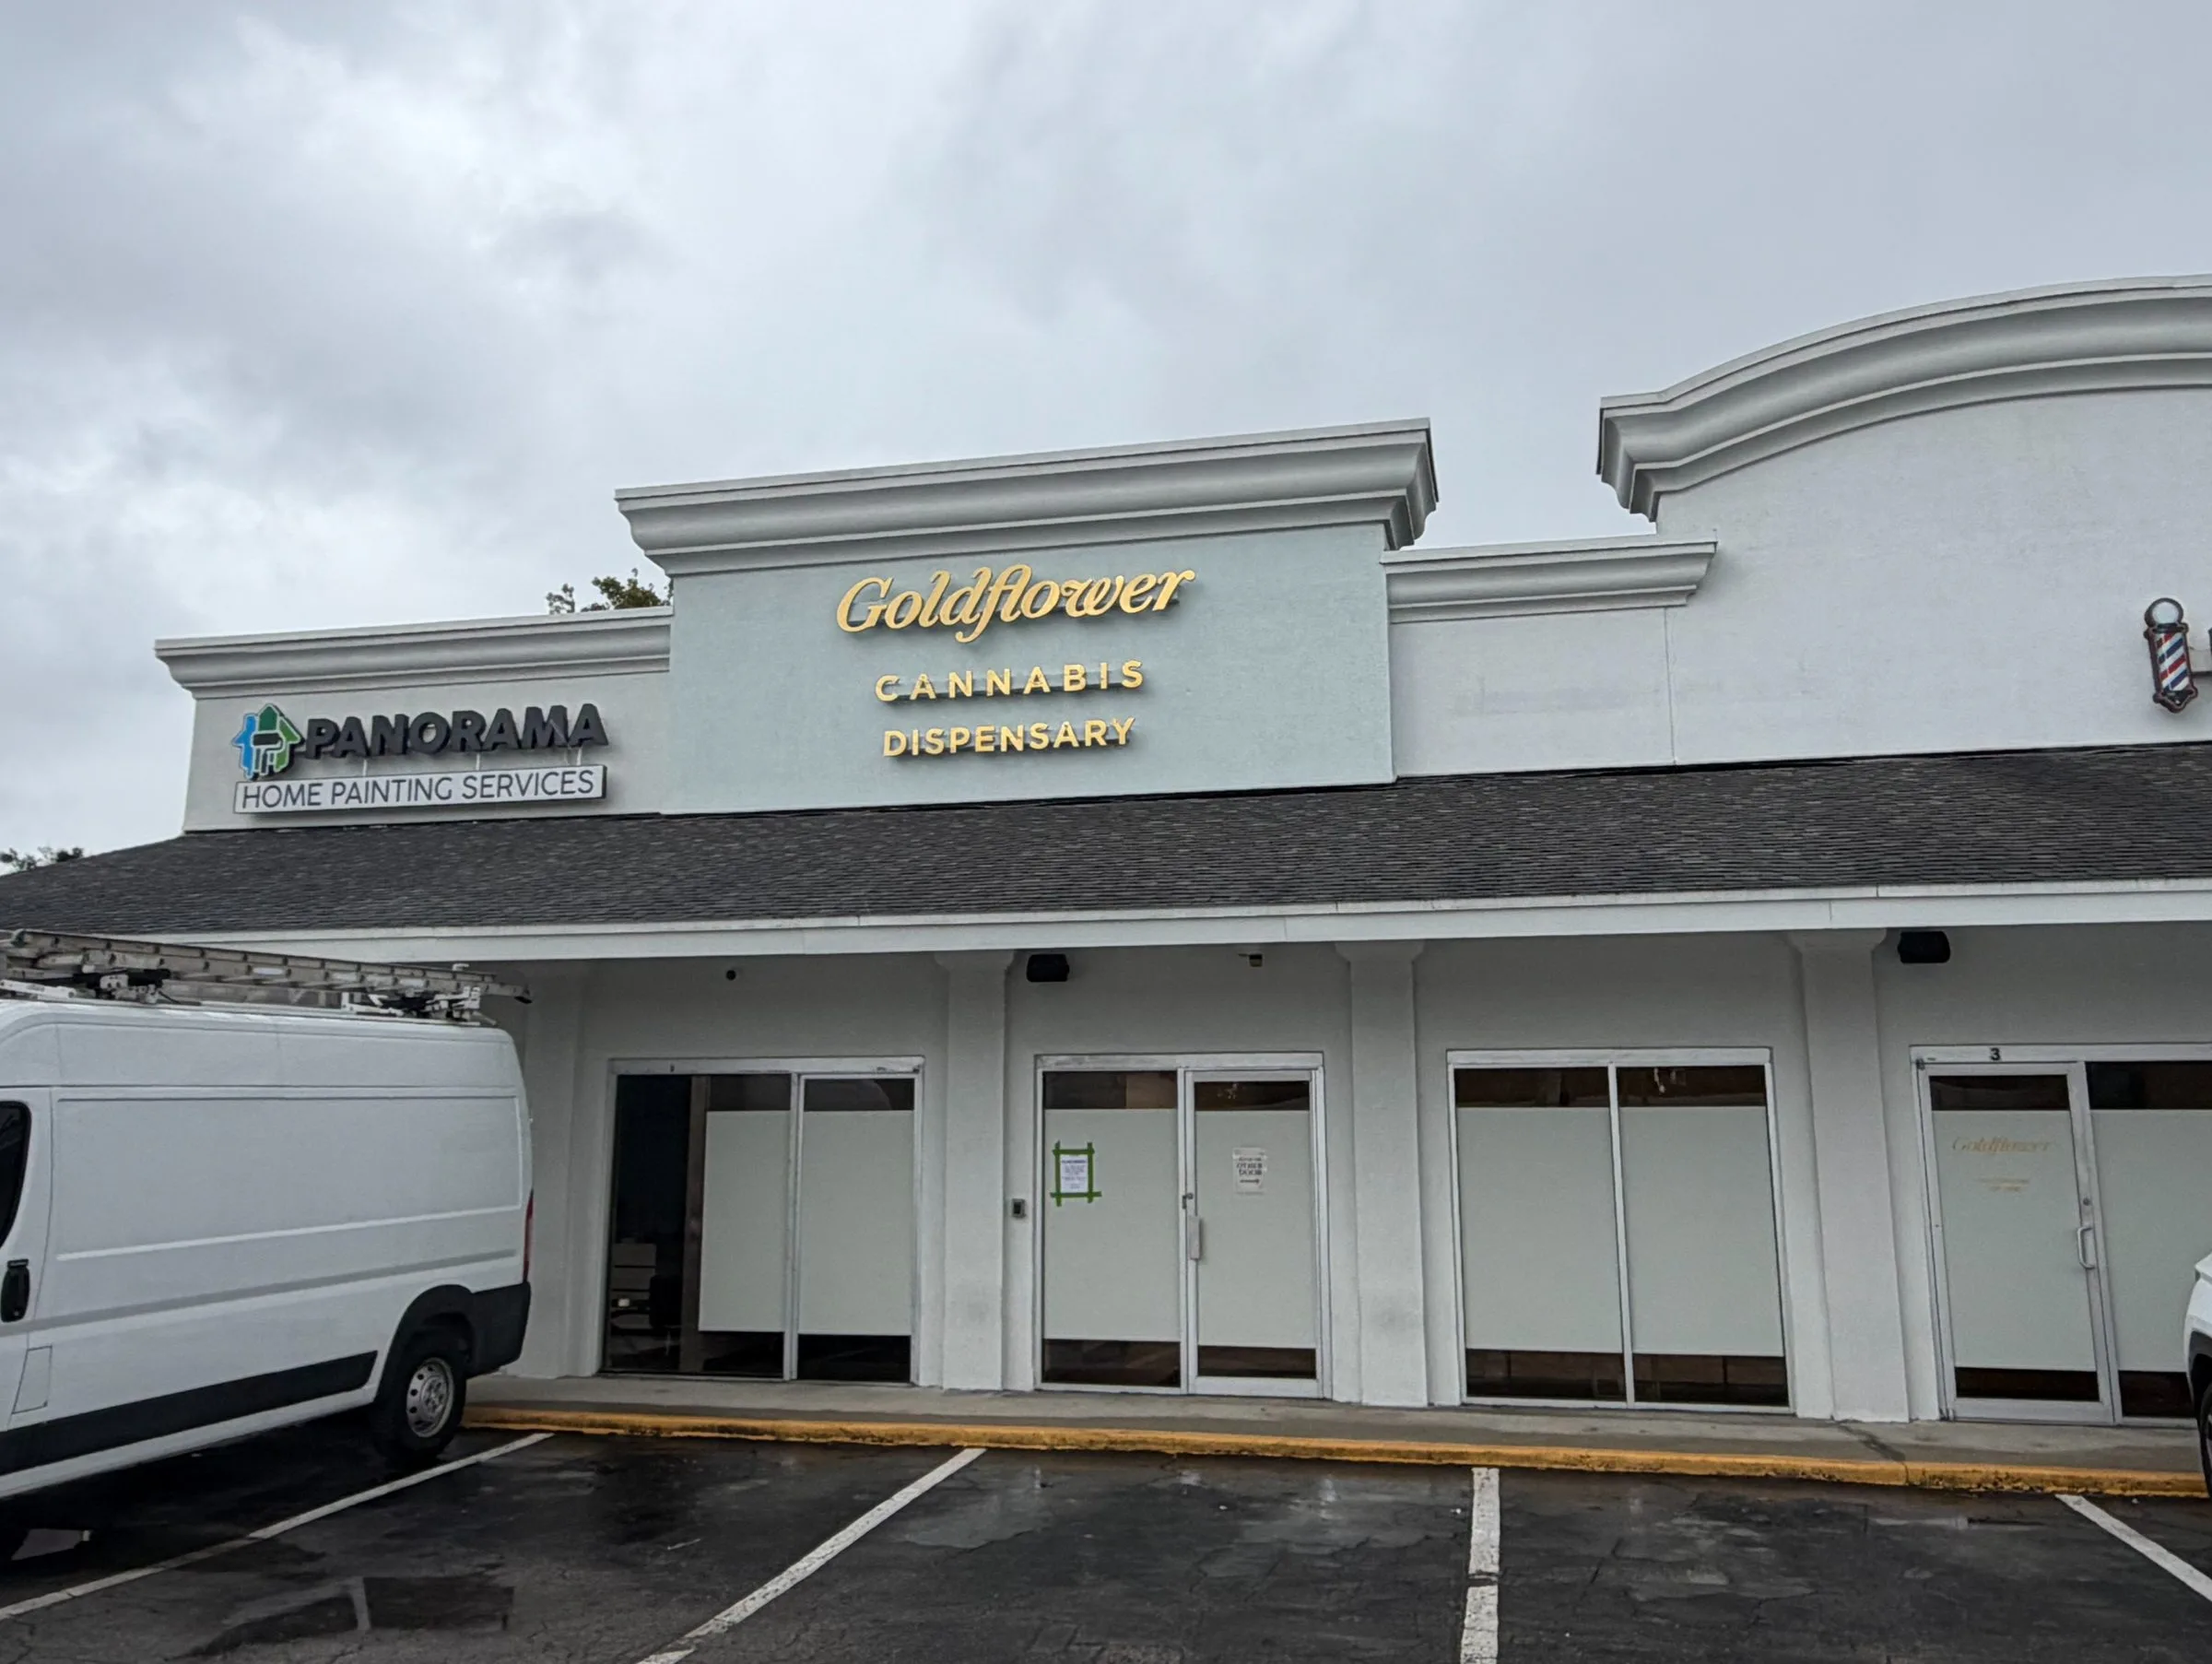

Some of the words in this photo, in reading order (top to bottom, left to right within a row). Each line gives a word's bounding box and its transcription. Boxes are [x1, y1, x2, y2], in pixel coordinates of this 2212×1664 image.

[836, 563, 1196, 643] Goldflower
[875, 659, 1144, 702] CANNABIS
[307, 702, 608, 759] PANORAMA
[882, 716, 1136, 758] DISPENSARY
[241, 780, 323, 808] HOME
[330, 774, 453, 805] PAINTING
[461, 769, 594, 799] SERVICES
[1990, 1047, 2001, 1060] 3
